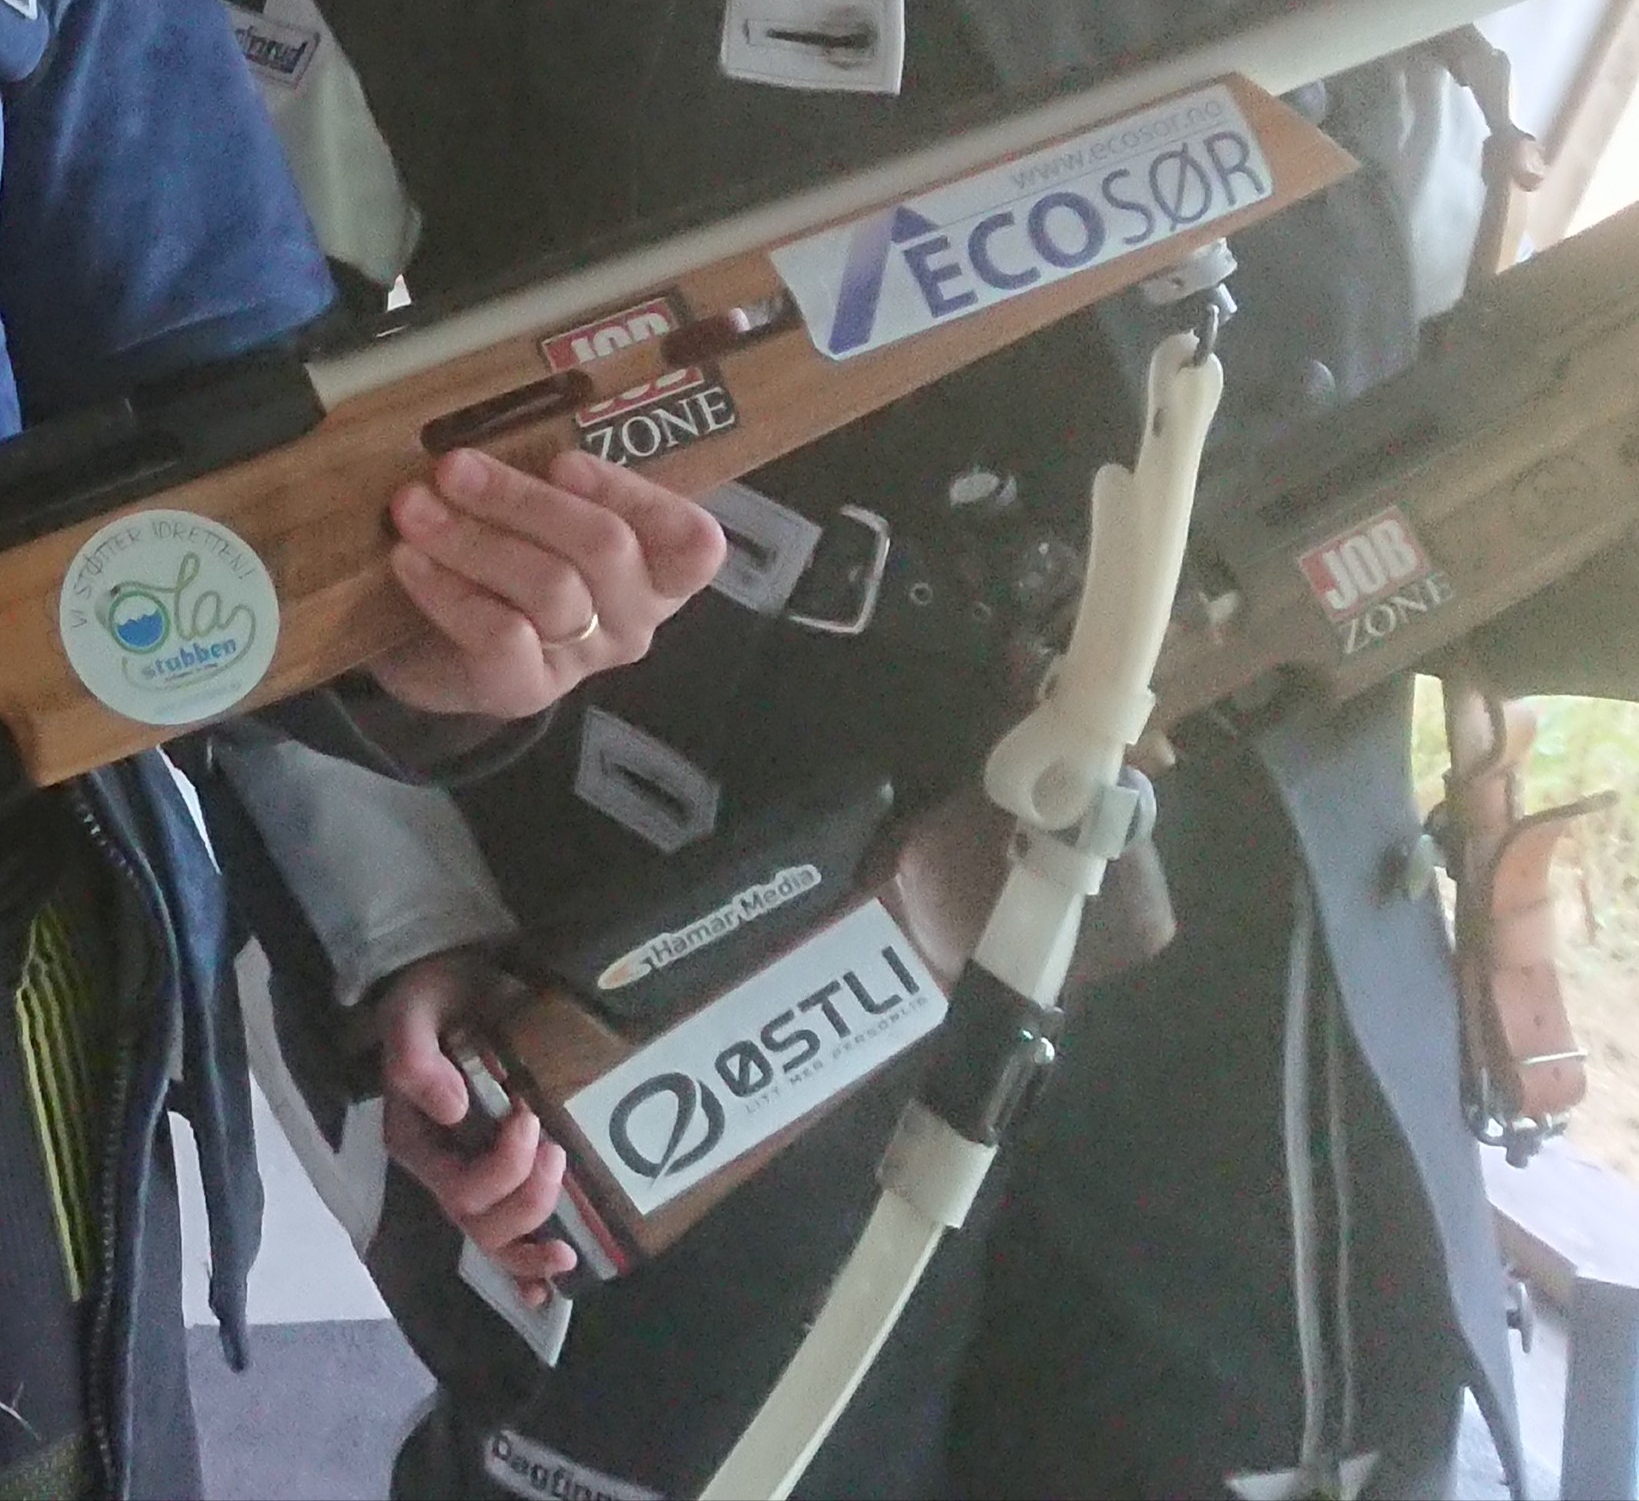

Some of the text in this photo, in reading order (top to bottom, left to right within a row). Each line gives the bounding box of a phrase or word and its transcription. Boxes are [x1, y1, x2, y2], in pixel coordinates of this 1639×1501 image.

[903, 129, 1266, 320] ECOSØR
[585, 385, 737, 466] ZONE
[1323, 519, 1419, 610] JOB
[140, 637, 237, 681] stubben
[1337, 578, 1455, 655] ZONE
[654, 864, 817, 962] Hamar Media
[713, 945, 921, 1099] ØSTLI
